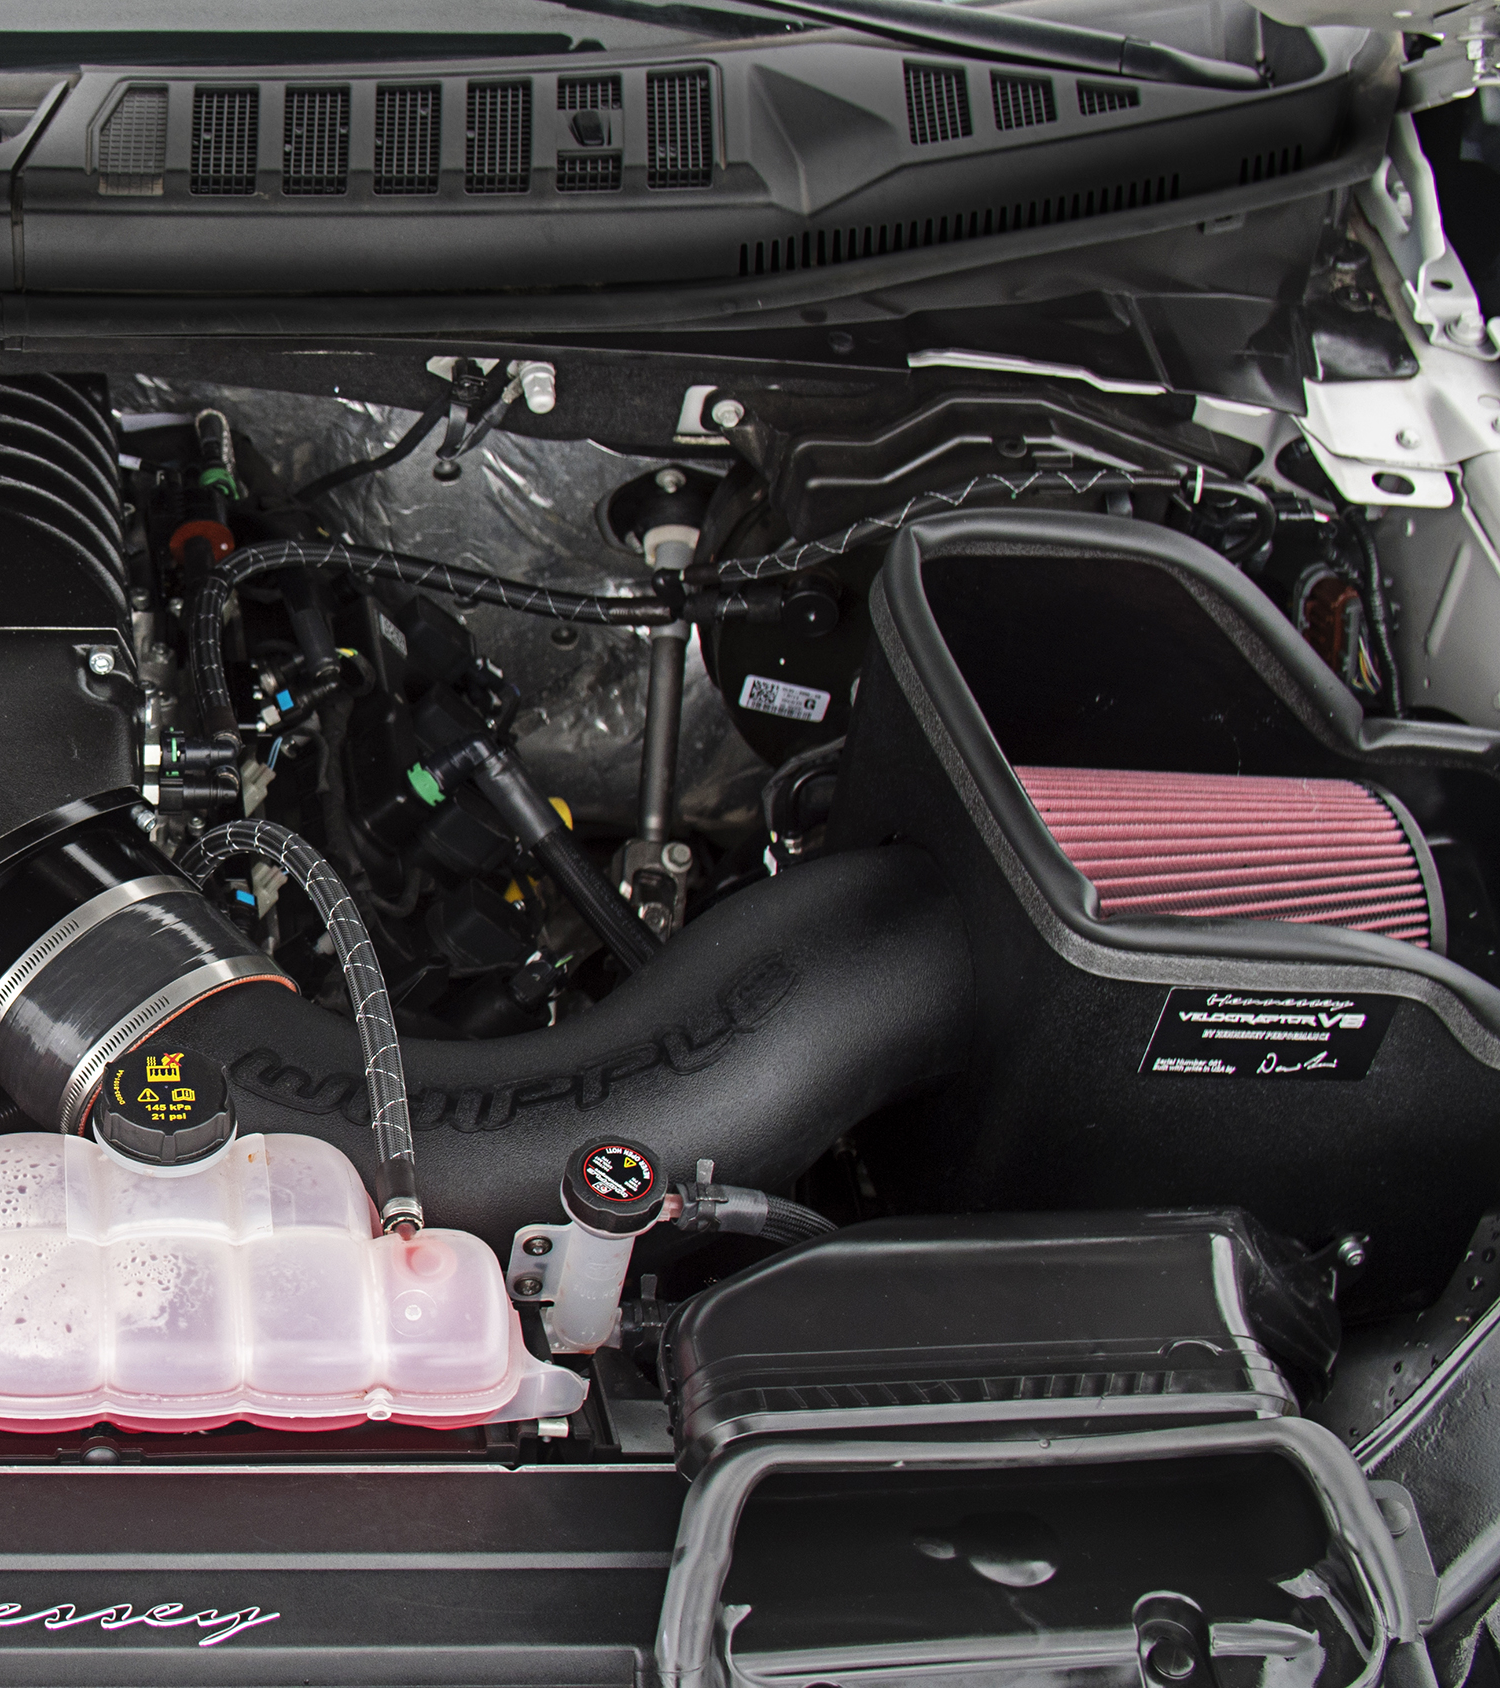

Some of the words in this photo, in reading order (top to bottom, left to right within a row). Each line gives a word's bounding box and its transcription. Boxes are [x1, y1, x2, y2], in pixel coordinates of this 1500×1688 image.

[1206, 993, 1355, 1012] Hennessey
[145, 1104, 167, 1112] 145
[151, 1113, 166, 1121] 21
[169, 1112, 187, 1121] psi
[623, 1149, 642, 1162] OPEN
[638, 1160, 650, 1180] NEVER
